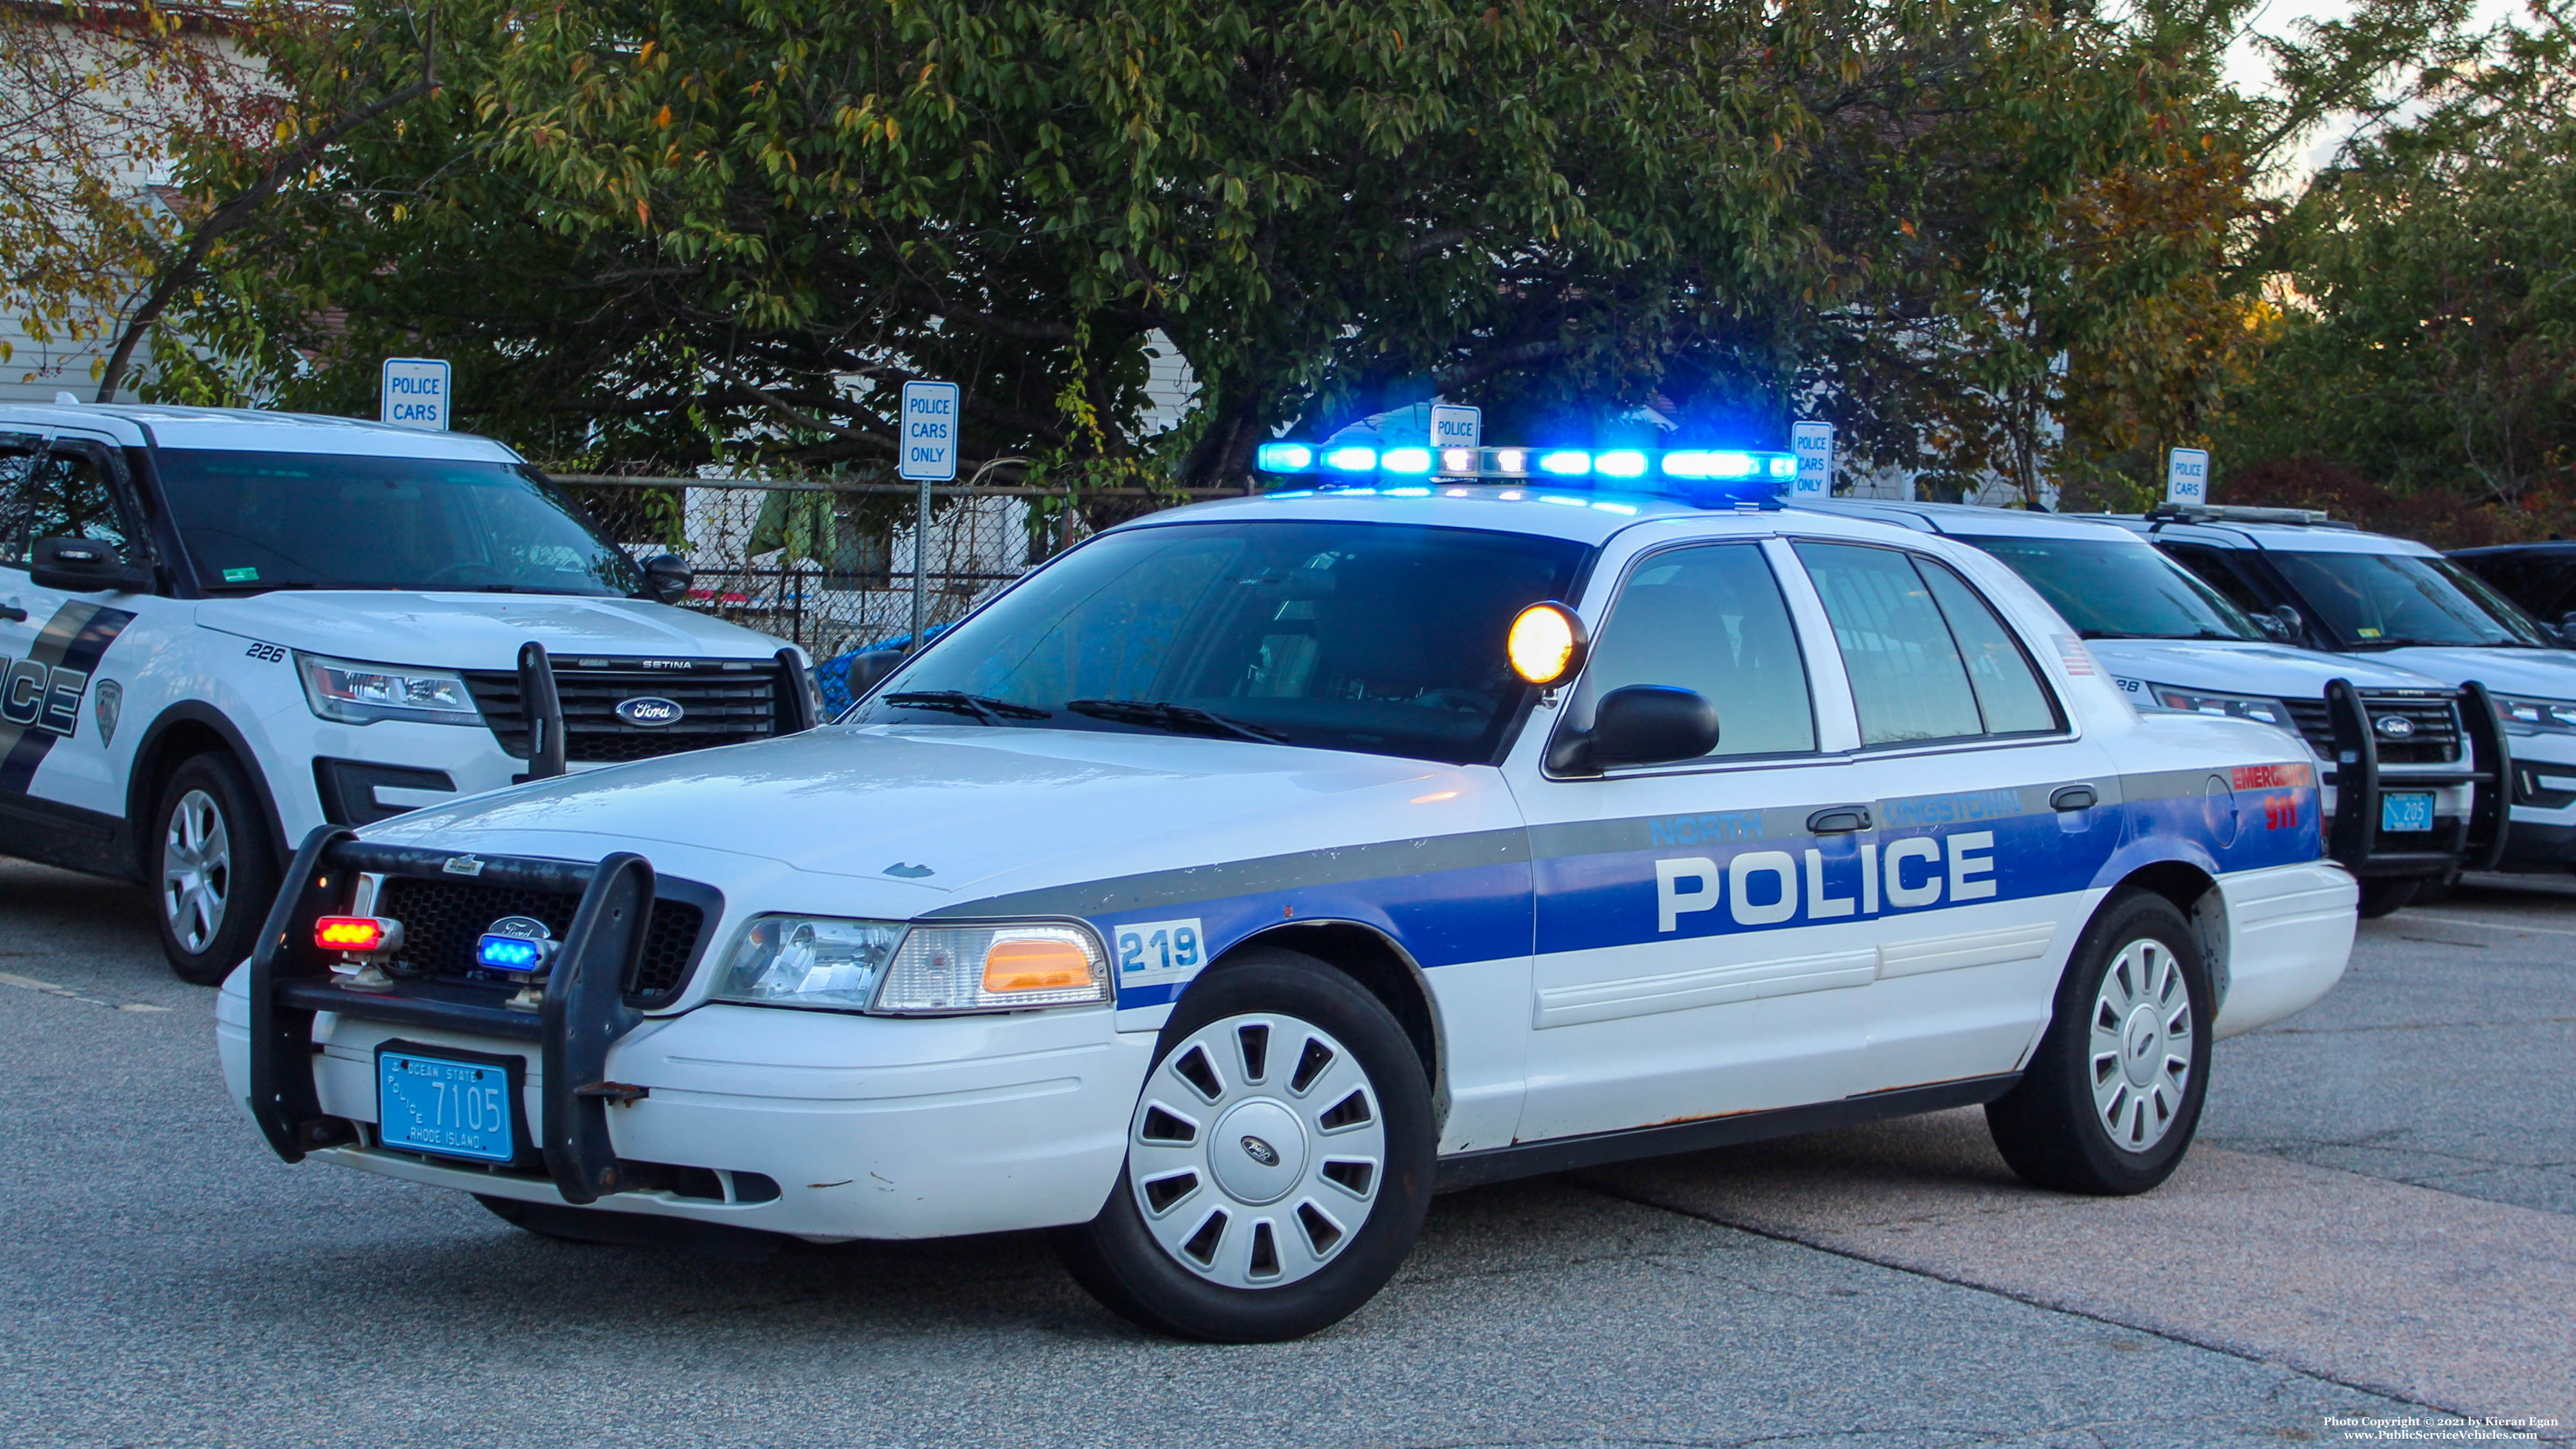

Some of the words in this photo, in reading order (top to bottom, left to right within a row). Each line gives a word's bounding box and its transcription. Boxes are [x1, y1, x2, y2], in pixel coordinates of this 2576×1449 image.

[392, 377, 439, 394] POLICE
[394, 403, 437, 421] CARS
[911, 399, 950, 414] POLICE
[912, 423, 947, 438] CARS
[1438, 421, 1473, 436] POLICE
[1797, 436, 1827, 450] POLICE
[911, 447, 945, 463] ONLY
[1798, 457, 1824, 471] CARS
[2176, 463, 2201, 477] POLICE
[1797, 478, 1822, 491] ONLY
[2175, 482, 2199, 496] CARS
[245, 643, 286, 663] 226
[643, 660, 692, 669] SETINA
[634, 702, 671, 718] Ford
[2387, 721, 2408, 732] Ford
[2265, 795, 2296, 830] 911
[2404, 802, 2425, 821] 205
[1649, 812, 1763, 847] NORTH
[1655, 830, 1996, 932] POLICE
[502, 922, 534, 937] Ford
[1119, 927, 1198, 972] 219
[408, 1063, 439, 1077] OCEAN
[447, 1069, 477, 1083] STATE
[432, 1082, 500, 1132] 7105
[410, 1127, 440, 1143] RHODE
[446, 1132, 479, 1149] ISLAND
